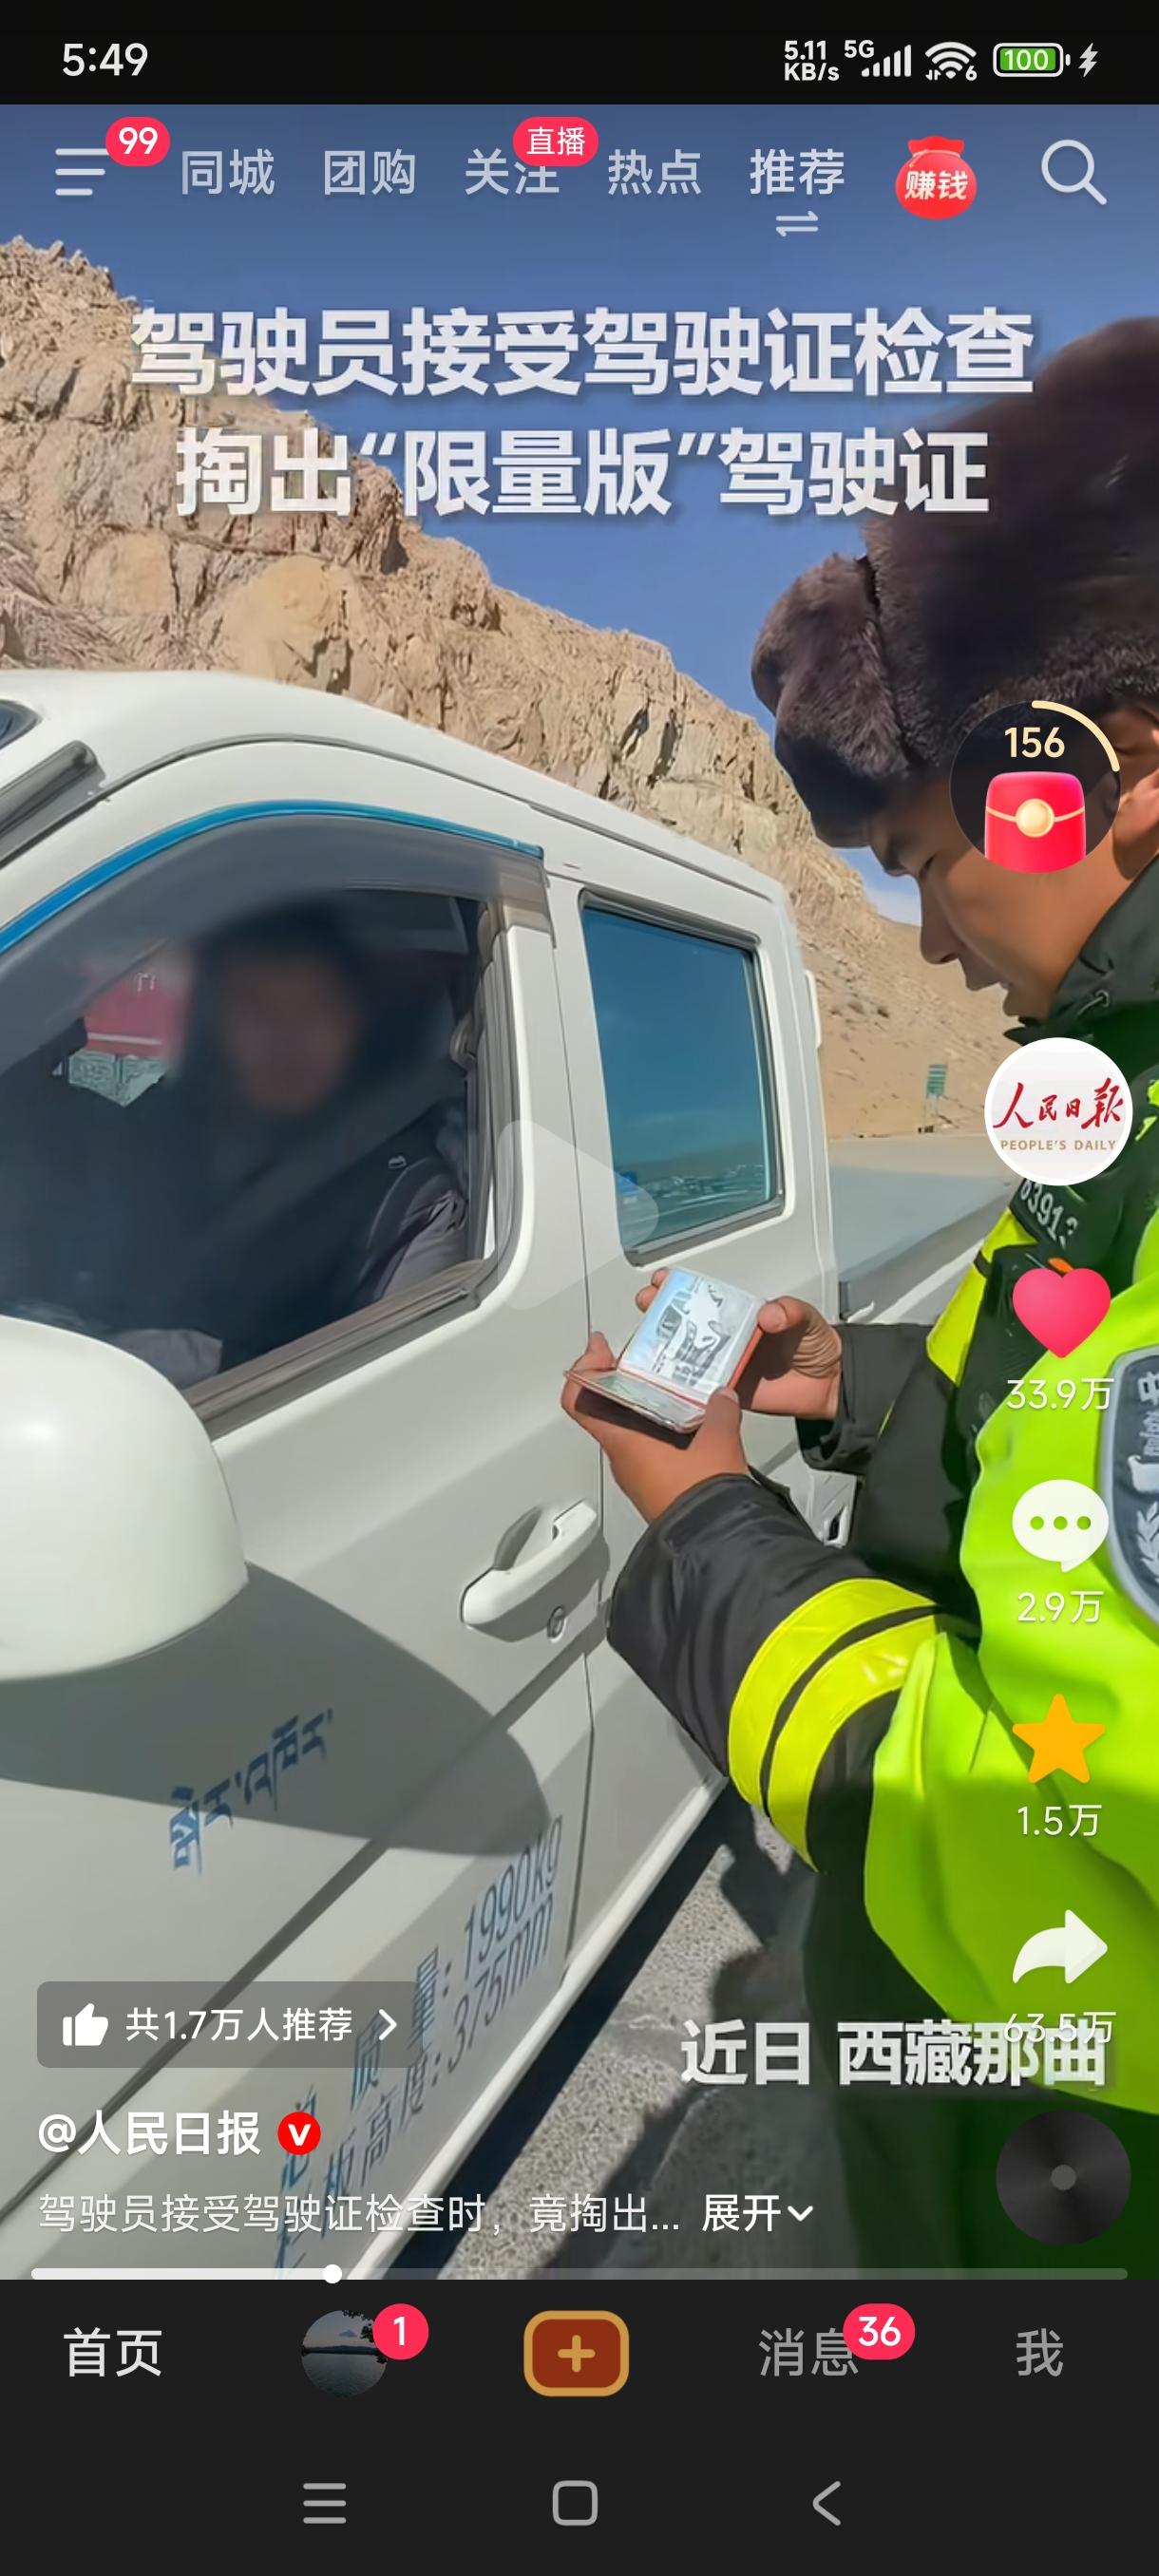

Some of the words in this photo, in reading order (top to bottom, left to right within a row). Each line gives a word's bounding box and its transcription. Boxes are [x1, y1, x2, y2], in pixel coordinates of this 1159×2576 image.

[63, 42, 148, 77] 5:49
[784, 40, 826, 61] 5.11
[844, 39, 875, 59] 5G
[1004, 48, 1049, 71] 100
[784, 62, 840, 82] KB/s
[119, 126, 158, 155] 99
[526, 125, 586, 156] 直播
[181, 148, 276, 196] 同城
[324, 148, 415, 196] 团购
[465, 147, 560, 196] 关注
[608, 148, 702, 196] 热点
[750, 148, 846, 196] 推荐
[904, 169, 969, 200] 赚钱
[1003, 726, 1066, 759] 156
[1074, 1140, 1116, 1151] DAILY
[1006, 1378, 1114, 1411] 33.9万
[1017, 1590, 1104, 1622] 2.9万
[1016, 1804, 1103, 1837] 1.5万
[125, 2006, 353, 2043] 共1.7万人推荐
[1003, 2011, 1116, 2044] 63.5万
[38, 2109, 261, 2157] @人民日报
[702, 2194, 782, 2232] 展开
[393, 2316, 408, 2346] 1
[857, 2316, 902, 2348] 36
[63, 2326, 162, 2377] 首页
[758, 2327, 858, 2377] 消息
[1016, 2327, 1065, 2378] 我
